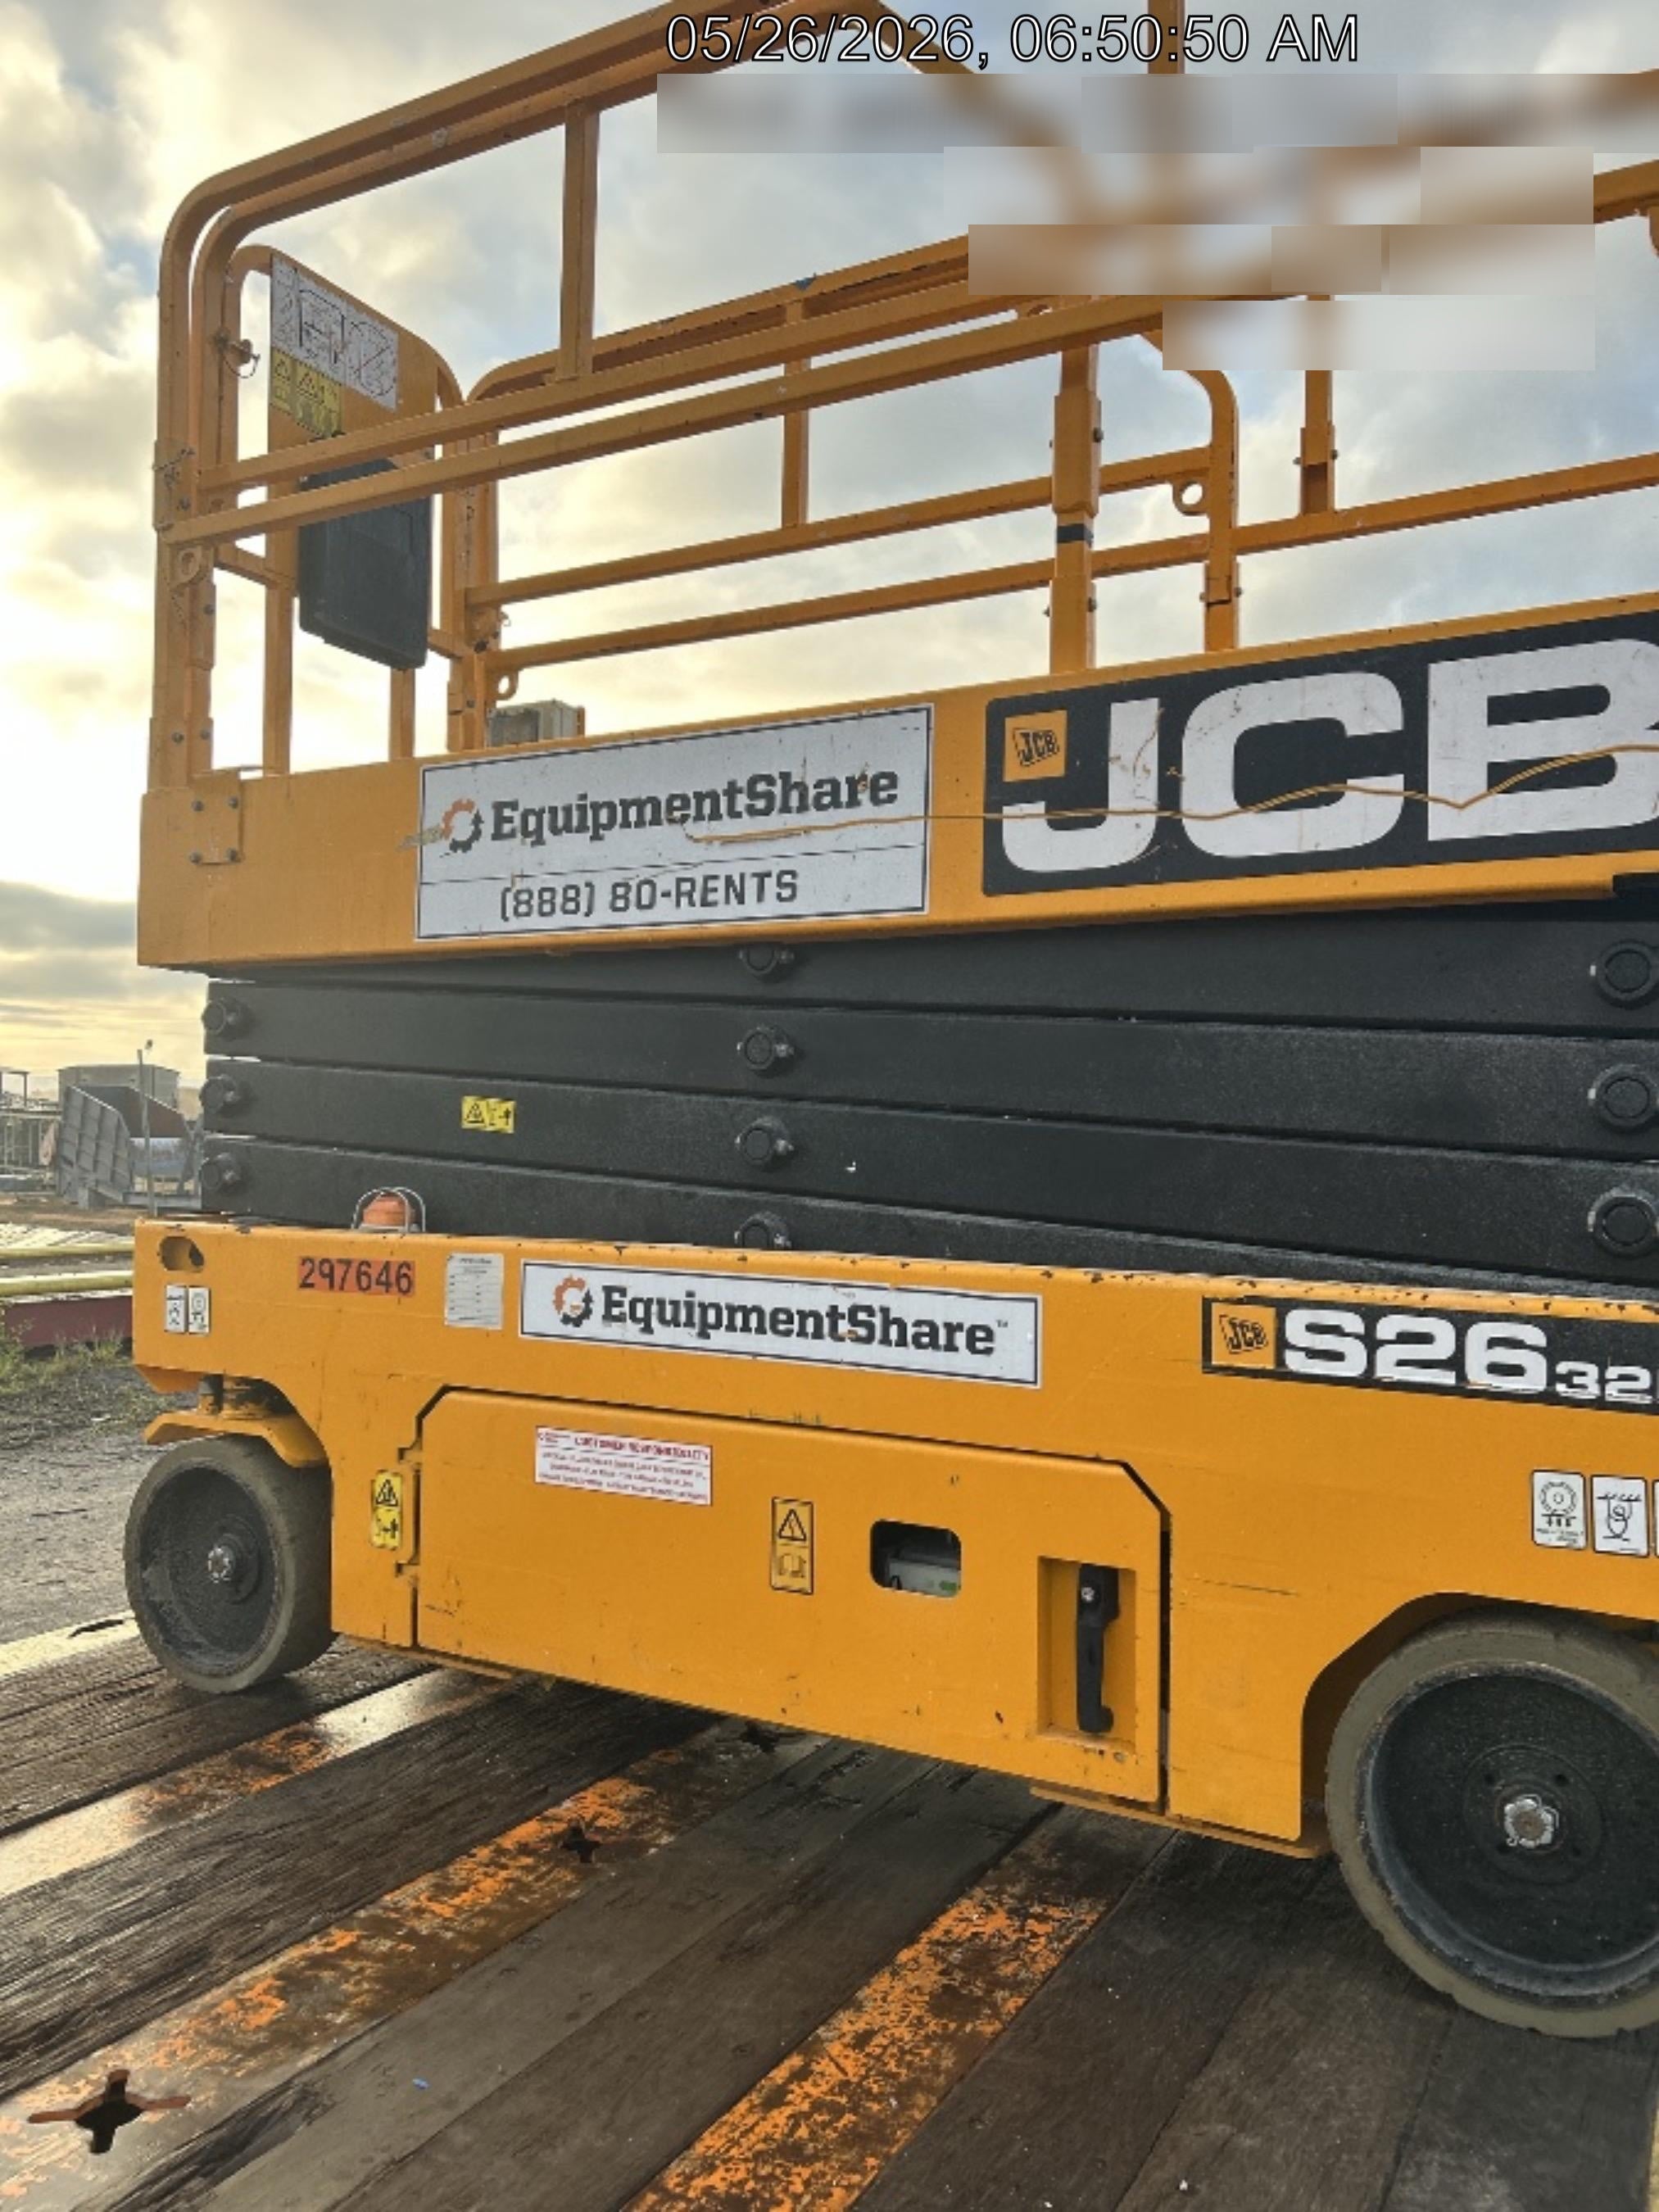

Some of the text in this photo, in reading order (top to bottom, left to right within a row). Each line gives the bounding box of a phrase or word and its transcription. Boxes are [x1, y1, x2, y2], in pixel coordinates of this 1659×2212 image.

[1002, 637, 1659, 873] JCB
[1016, 729, 1058, 765] JCB
[491, 770, 899, 846] EquipmentShare
[501, 869, 798, 922] (888) 80-RENTS
[299, 1258, 414, 1295] 297646
[1225, 1316, 1267, 1353] JCB
